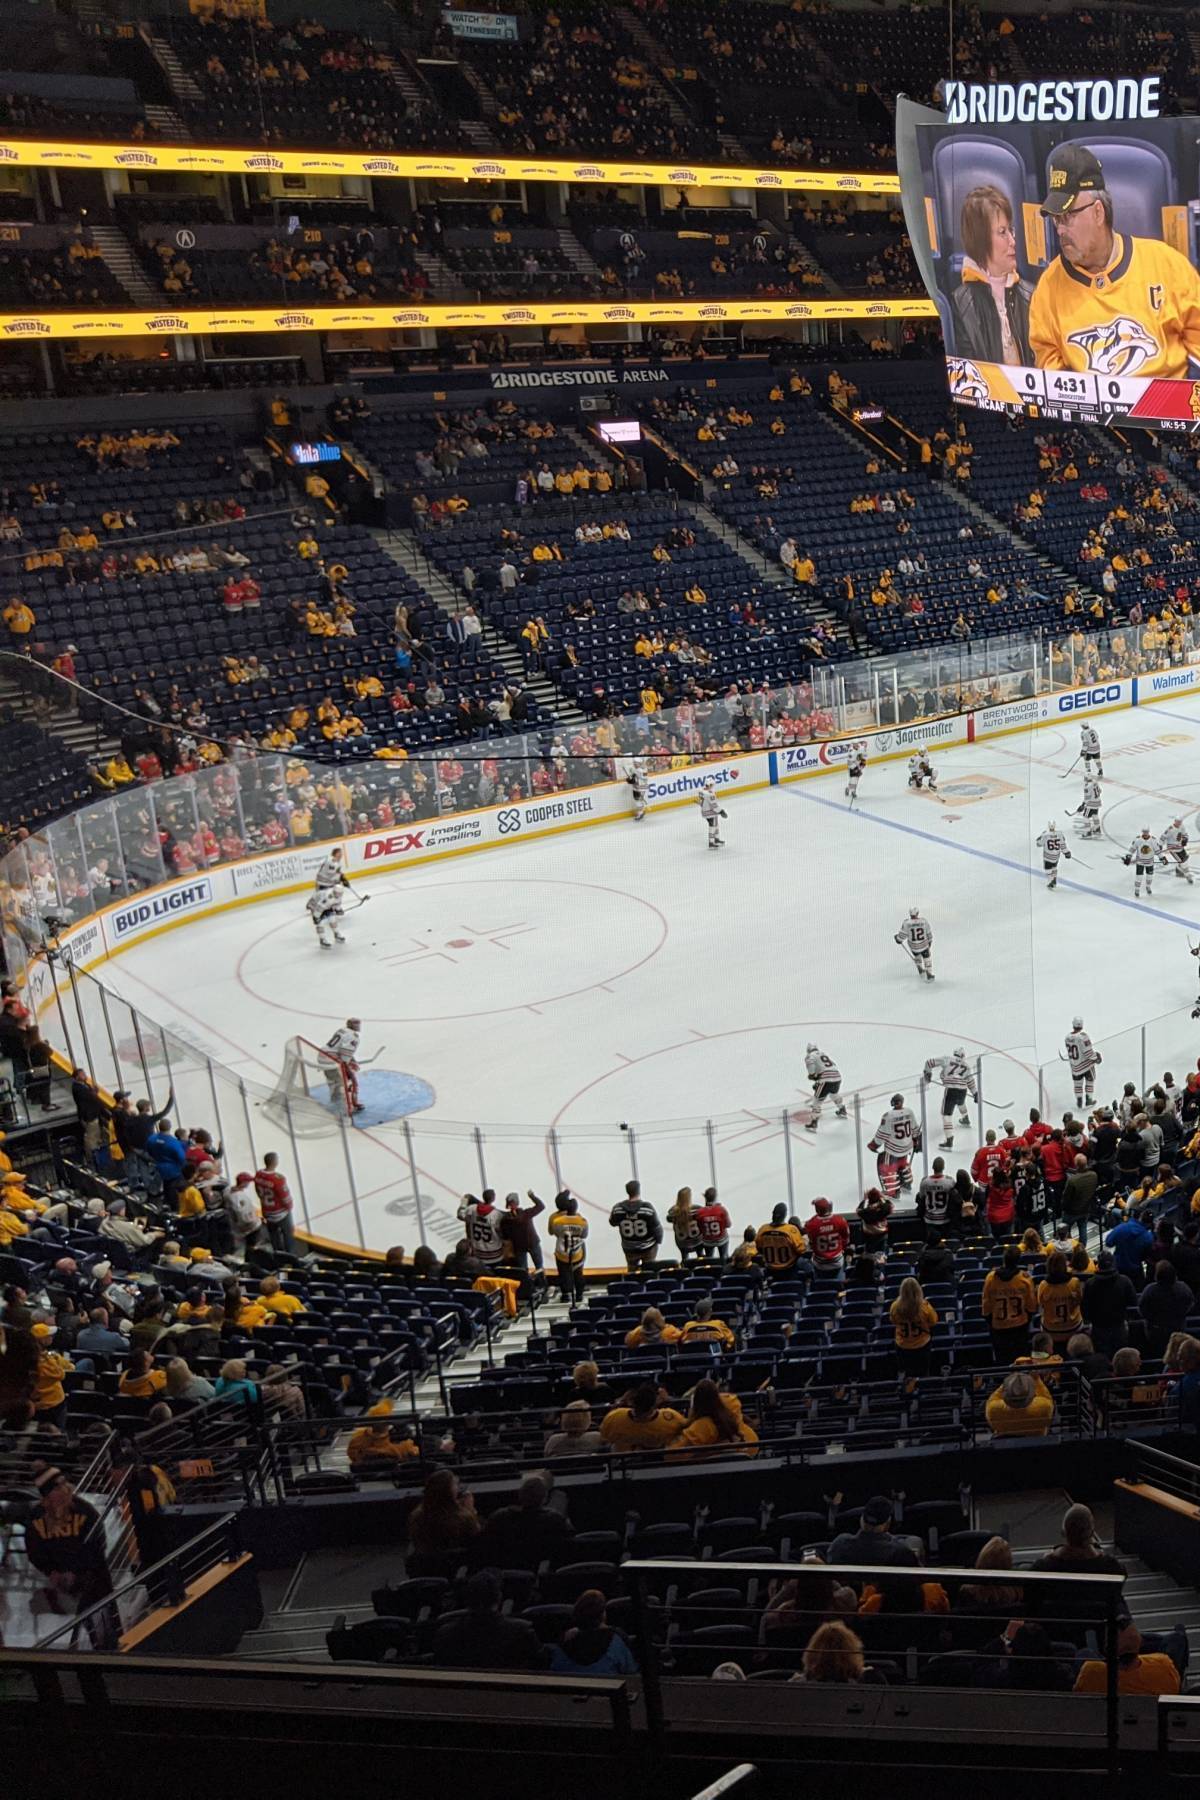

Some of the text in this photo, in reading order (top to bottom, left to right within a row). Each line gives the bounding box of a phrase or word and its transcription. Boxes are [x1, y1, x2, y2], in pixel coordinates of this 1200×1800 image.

[946, 78, 1160, 124] BRIDGESTONE
[4, 149, 19, 160] TEA
[114, 154, 158, 165] TWISTED TEA
[244, 158, 284, 169] TWISTED TEA
[362, 162, 399, 172] TWISTED TEA
[304, 230, 321, 241] 210
[1150, 284, 1164, 310] C
[145, 319, 189, 330] TWISTED TEA
[274, 316, 314, 327] TWISTED TEA
[393, 313, 429, 324] TWISTED TEA
[3, 322, 51, 334] TWISTED TEA
[491, 370, 669, 388] BRIDGESTONE ARENA
[1025, 373, 1036, 390] 0
[1054, 377, 1086, 394] 4:31
[1109, 380, 1120, 399] 0
[979, 401, 1005, 412] NCAAF
[1013, 404, 1023, 413] UK
[1042, 408, 1058, 418] VAN
[1104, 403, 1111, 413] 0
[1161, 421, 1172, 430] UK:
[1153, 671, 1194, 690] Walmart
[1059, 685, 1120, 712] GEICO
[983, 702, 1038, 720] BRENTWOOD
[984, 712, 1038, 728] AUTO BROKERS
[1090, 733, 1096, 743] 2
[787, 758, 818, 770] MILLION
[526, 797, 593, 823] COOPER STEEL
[432, 821, 480, 836] imaging
[438, 829, 481, 844] mailing
[364, 830, 425, 859] DEX
[1047, 840, 1060, 850] 65
[116, 884, 206, 932] BUD LIGHT
[72, 926, 97, 949] DOWNLOAD
[911, 928, 924, 941] 12
[948, 1062, 967, 1076] 77
[894, 1120, 910, 1139] 50
[925, 1191, 949, 1210] 19
[1032, 1193, 1045, 1211] 19
[621, 1220, 648, 1236] 88
[703, 1222, 720, 1236] 19
[818, 1233, 839, 1251] 65
[995, 1297, 1022, 1321] 33
[1056, 1304, 1067, 1321] 9
